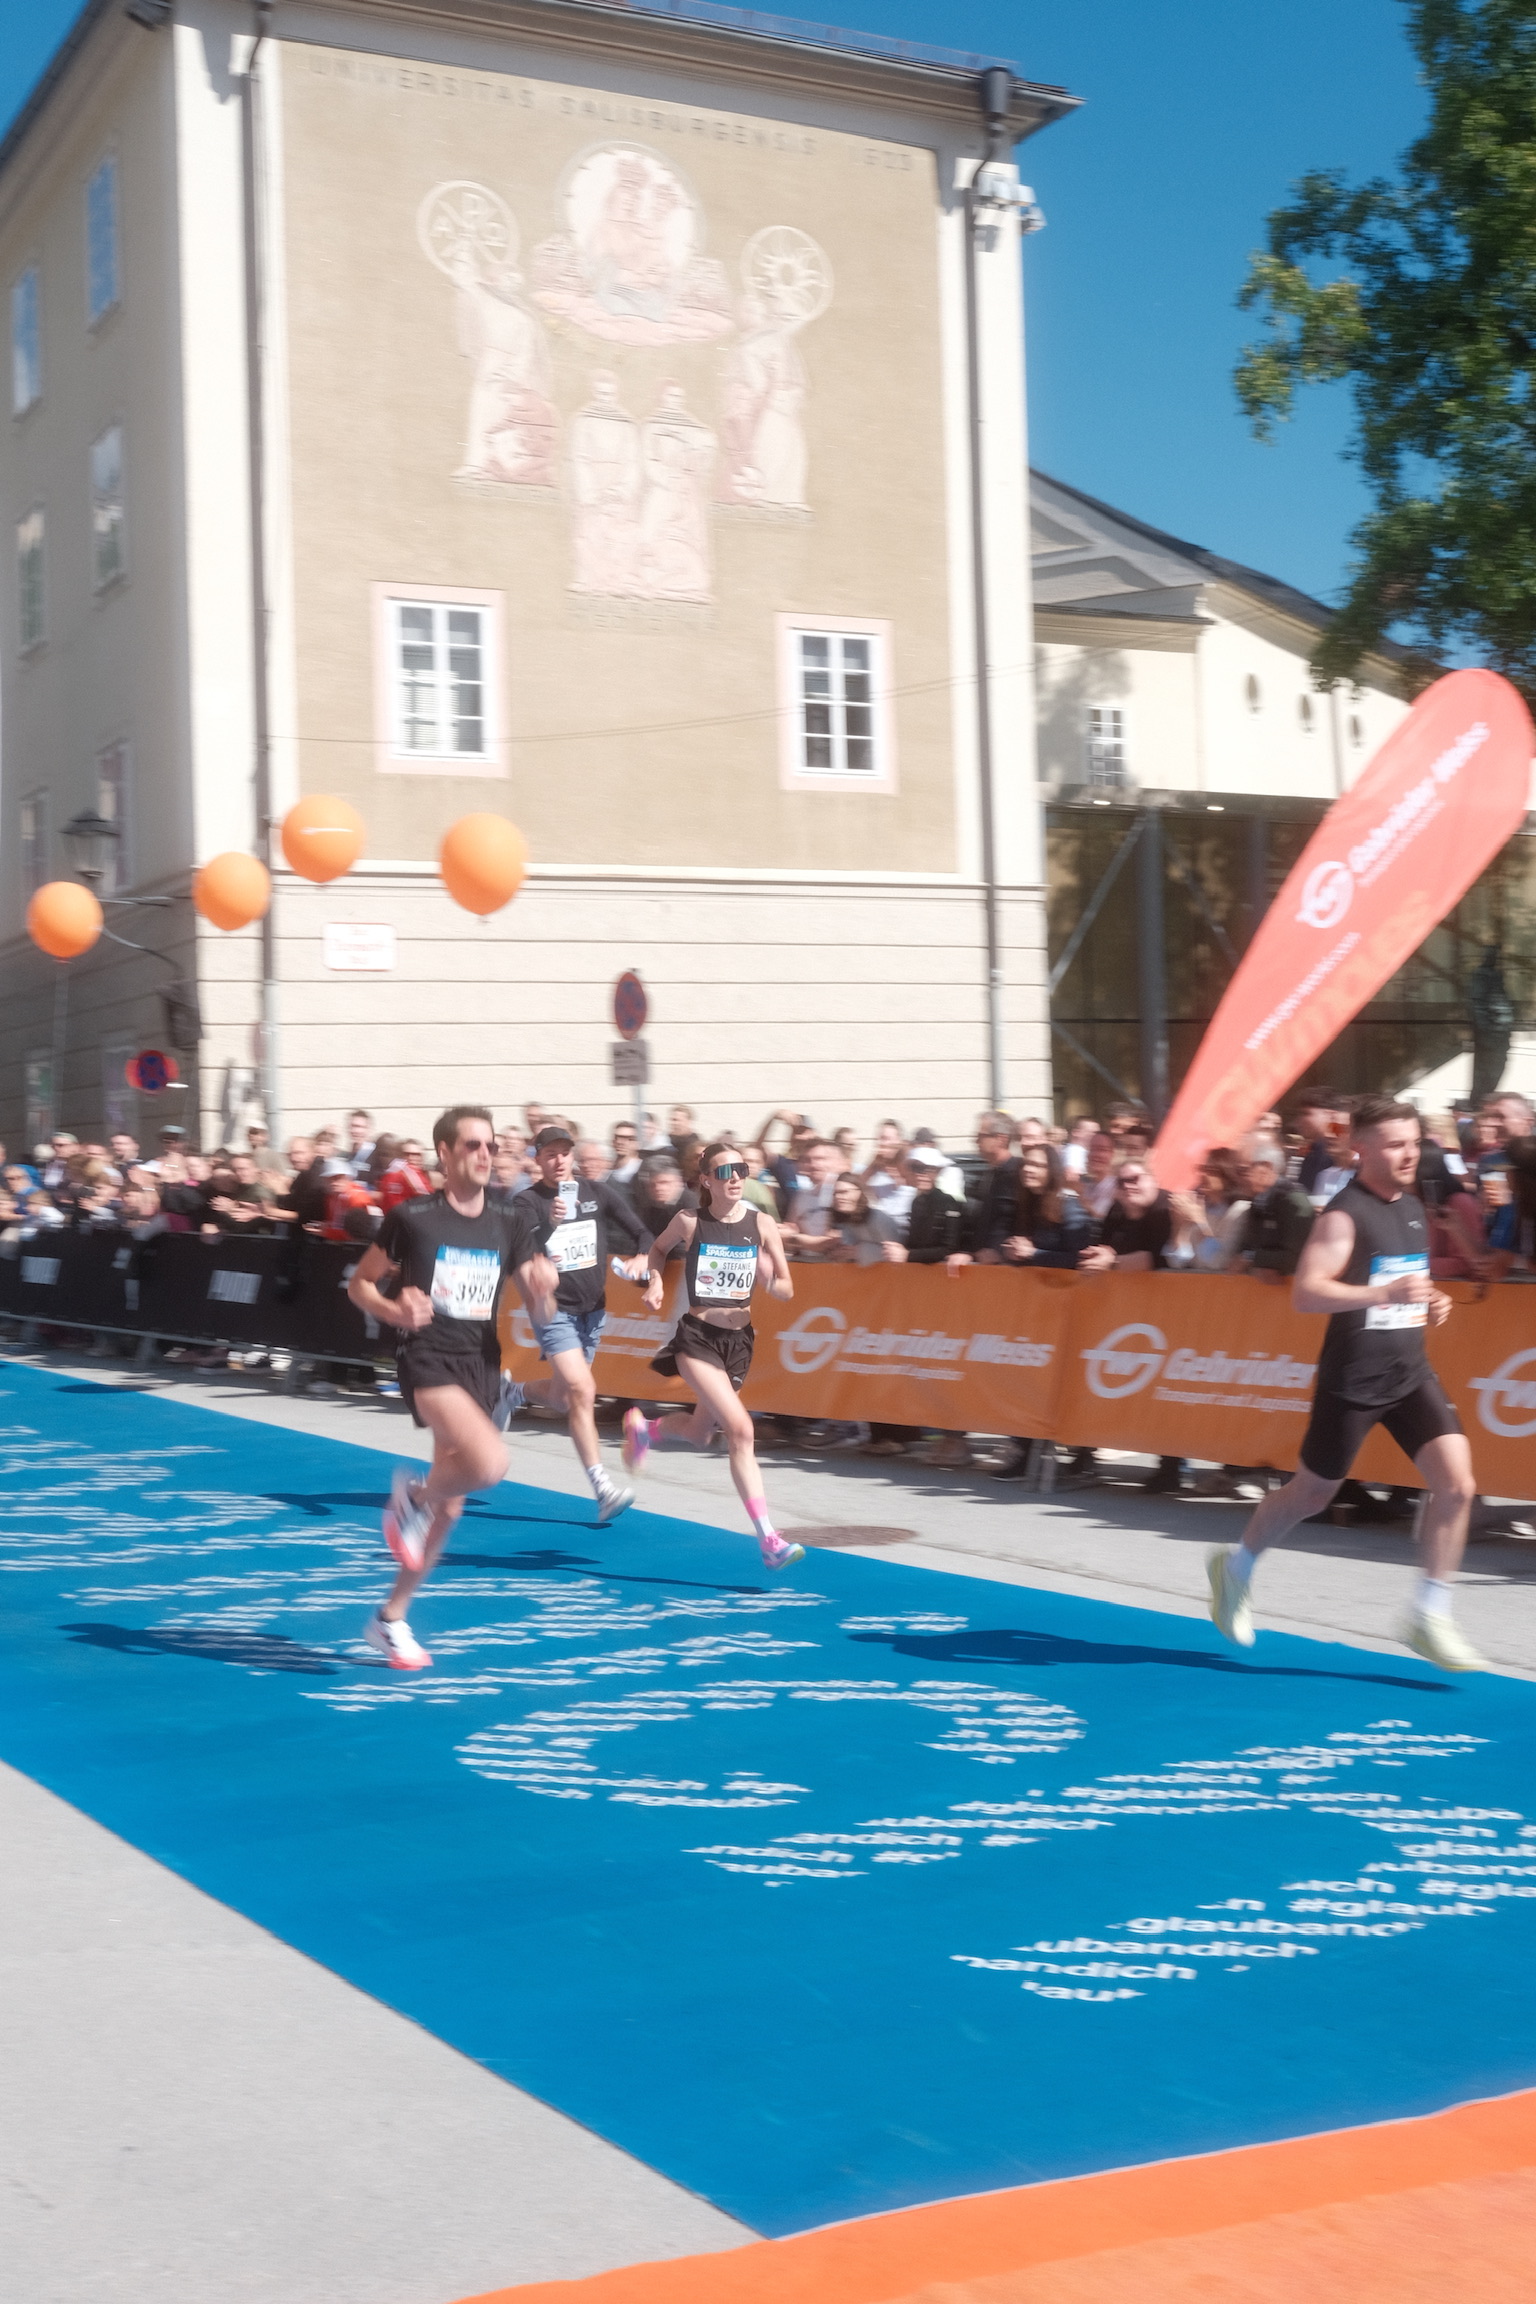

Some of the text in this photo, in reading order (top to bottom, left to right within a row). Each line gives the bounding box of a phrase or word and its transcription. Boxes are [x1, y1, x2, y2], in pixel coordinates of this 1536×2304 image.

[706, 1249, 747, 1259] SPARKASSE
[722, 1261, 752, 1271] STEFANIE
[716, 1270, 753, 1288] 3960
[1010, 1936, 1320, 1958] ubandich
